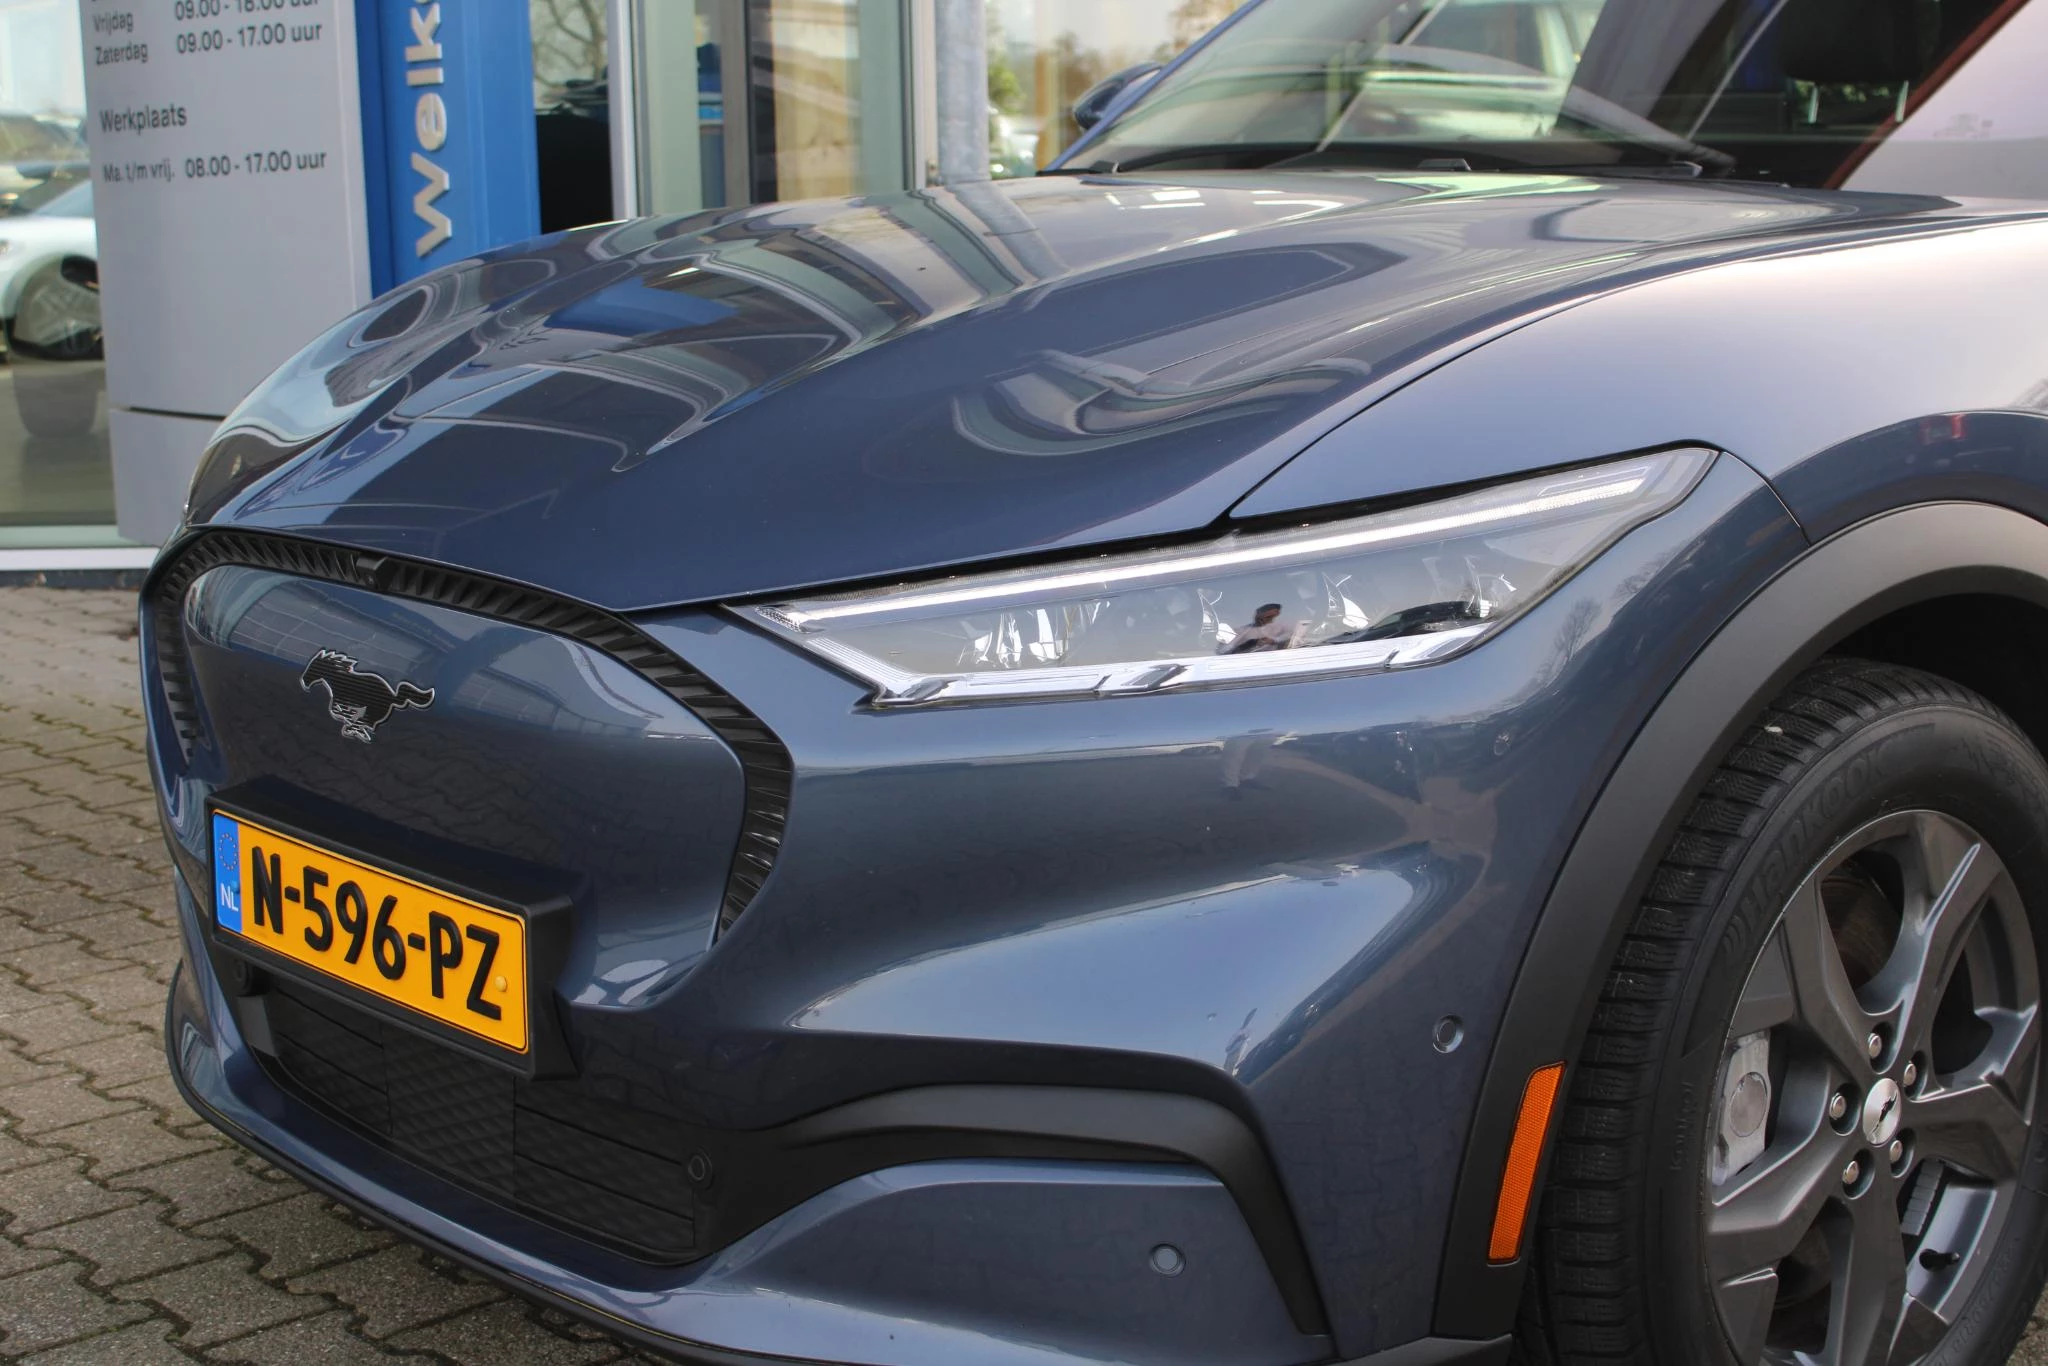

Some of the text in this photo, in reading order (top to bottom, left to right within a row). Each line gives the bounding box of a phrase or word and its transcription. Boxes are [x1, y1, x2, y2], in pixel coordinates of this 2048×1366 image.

[93, 11, 134, 36] Vrijdag
[175, 0, 220, 20] 09.00
[94, 43, 149, 66] Zaterdag
[176, 30, 223, 54] 09.00
[237, 23, 286, 47] 17.00
[291, 24, 323, 43] uur
[100, 104, 187, 135] Werkplaats
[405, 0, 452, 257] Welk
[126, 161, 148, 182] t/m
[149, 158, 175, 182] vrij.
[185, 155, 231, 178] 08.00
[245, 150, 292, 174] 17.00
[297, 153, 327, 170] uur
[220, 845, 502, 1022] NL N-596-PZ
